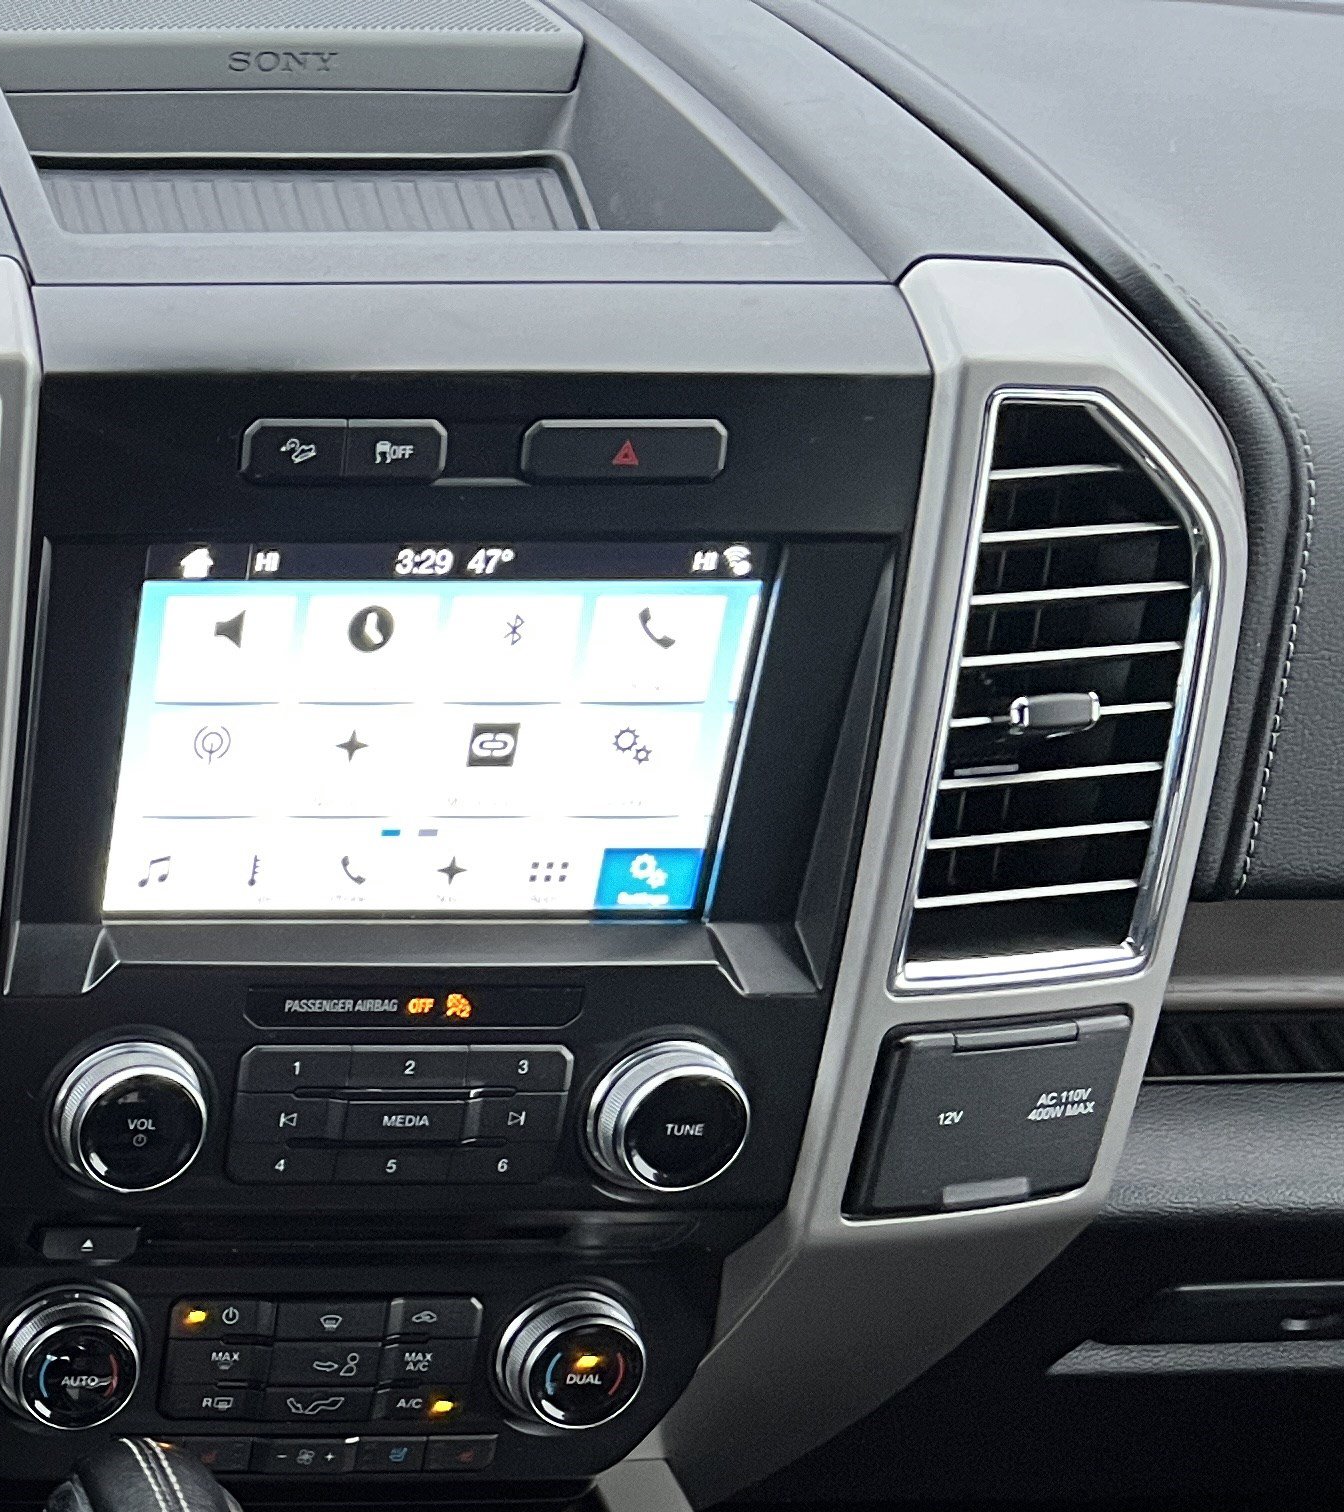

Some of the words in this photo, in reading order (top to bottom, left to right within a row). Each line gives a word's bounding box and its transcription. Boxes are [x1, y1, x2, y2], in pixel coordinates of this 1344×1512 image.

[227, 51, 338, 72] SONY
[391, 445, 414, 461] OFF
[254, 551, 280, 572] HI
[395, 549, 453, 574] 3:29
[466, 549, 516, 574] 47°
[691, 551, 718, 572] HI
[284, 999, 354, 1013] PASSENGER
[354, 999, 399, 1013] AIRBAG
[408, 998, 435, 1014] OFF
[292, 1061, 302, 1075] 1
[404, 1062, 415, 1075] 2
[518, 1060, 529, 1074] 3
[1037, 1092, 1058, 1106] AC
[1060, 1087, 1092, 1104] 110V
[937, 1110, 964, 1126] 12V
[1027, 1105, 1064, 1122] 400W
[1065, 1100, 1096, 1117] MAX
[127, 1118, 157, 1131] VOL
[382, 1113, 431, 1128] MEDIA
[665, 1122, 704, 1137] TUNE
[274, 1159, 286, 1172] 4
[385, 1159, 397, 1173] 5
[497, 1158, 509, 1173] 6
[211, 1352, 240, 1362] MAX
[404, 1352, 433, 1362] MAX
[405, 1361, 430, 1372] A/C
[60, 1374, 100, 1388] AUTO
[565, 1373, 603, 1386] DUAL
[202, 1398, 212, 1408] R
[395, 1398, 423, 1409] A/C
